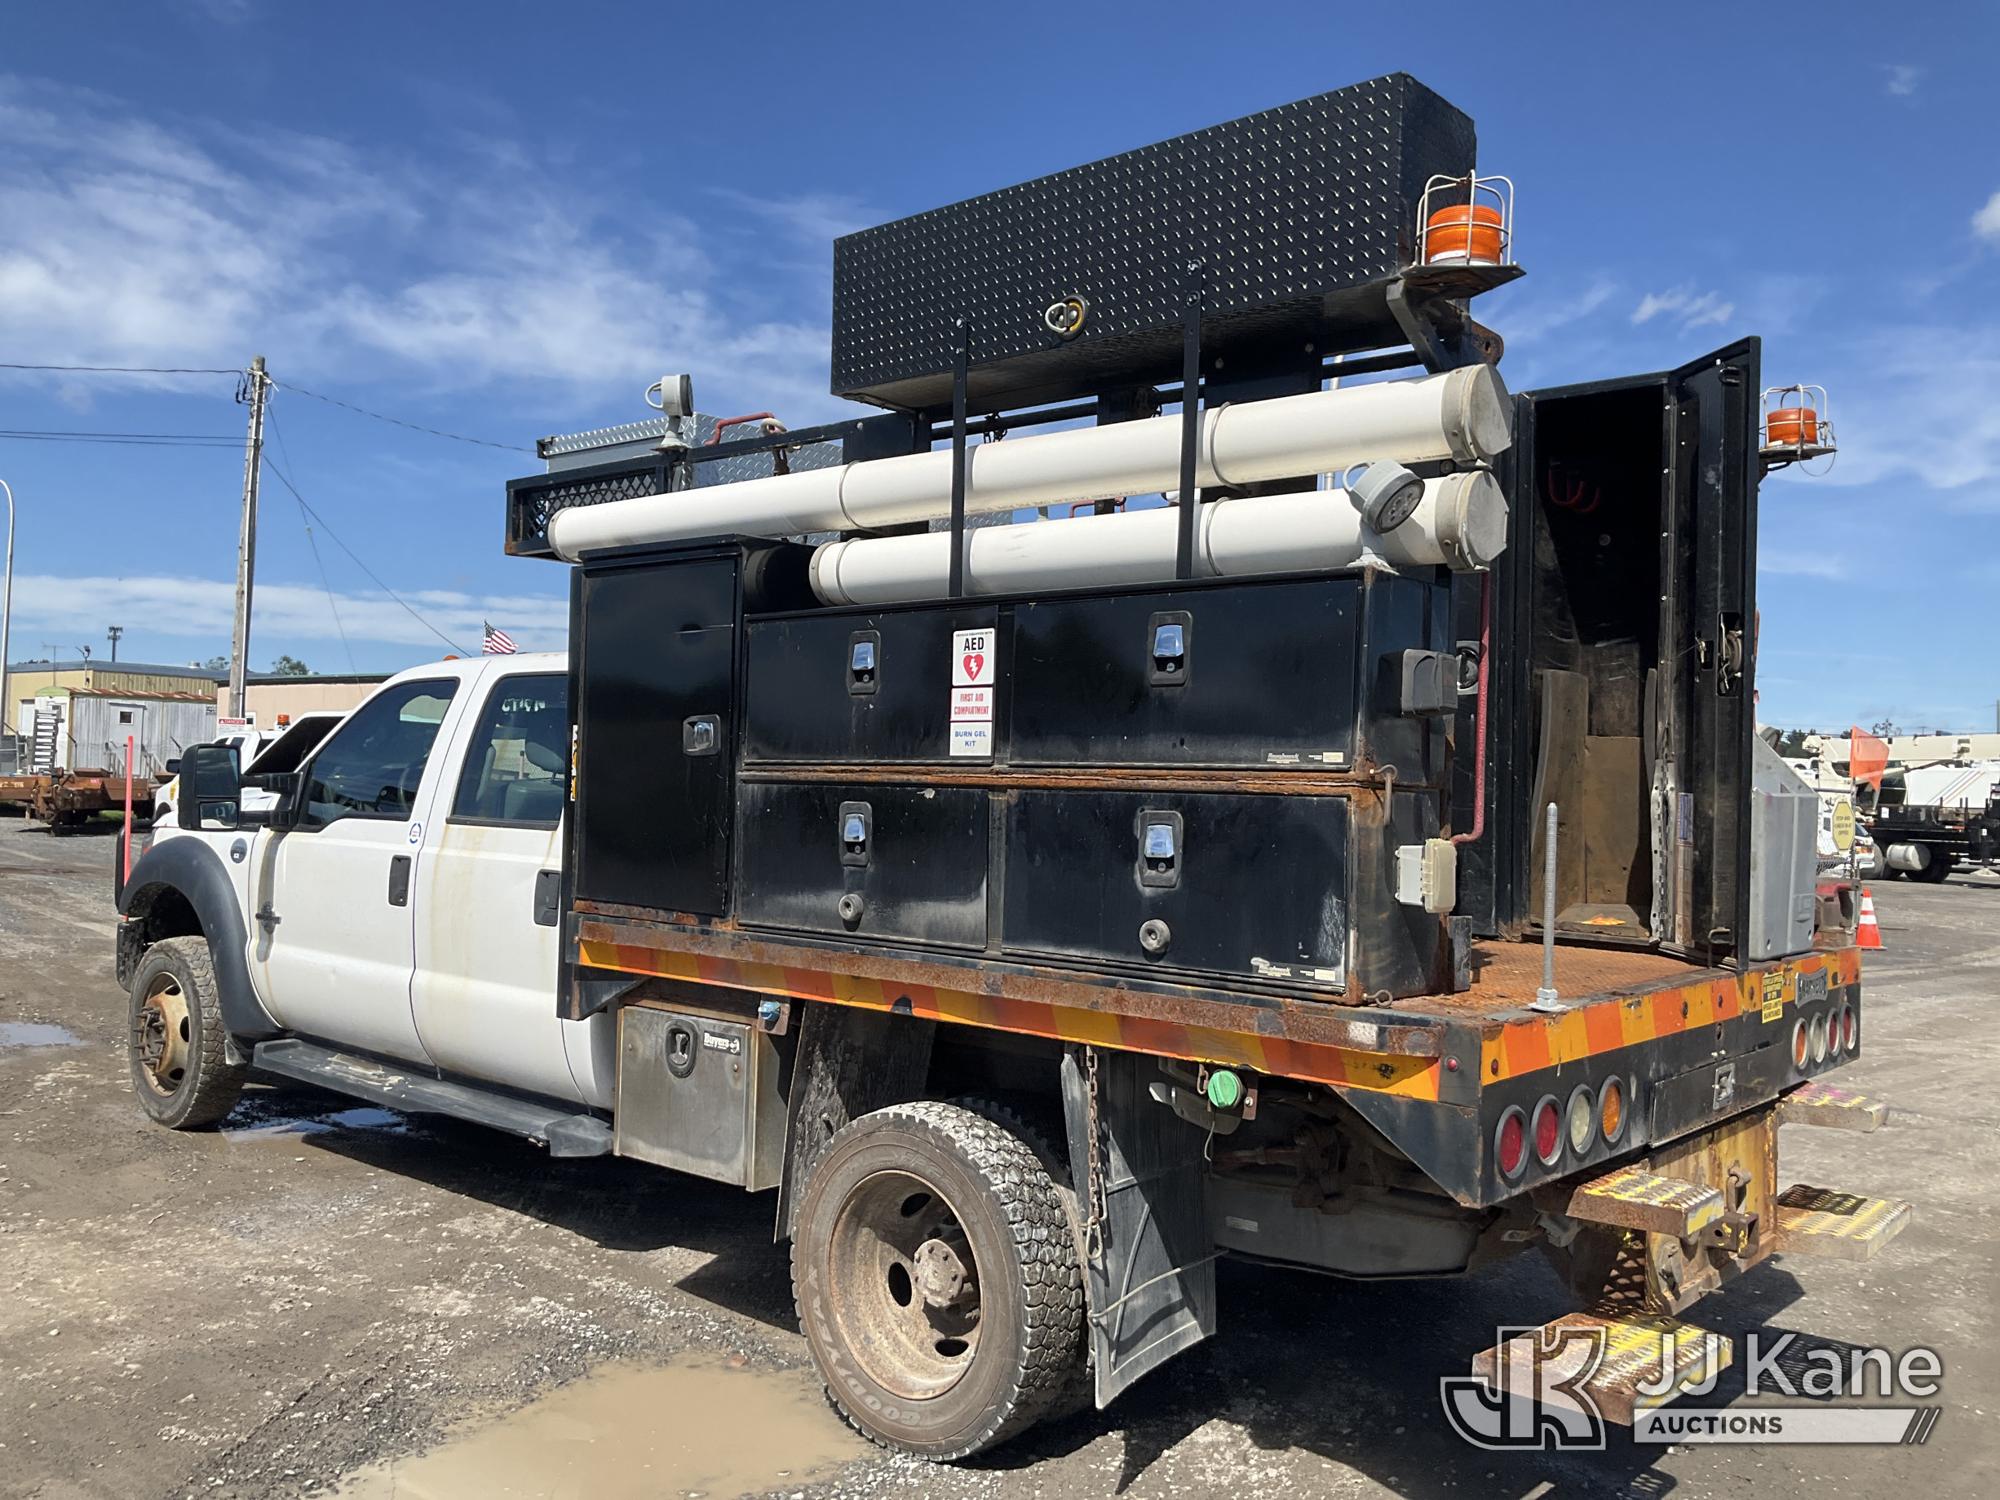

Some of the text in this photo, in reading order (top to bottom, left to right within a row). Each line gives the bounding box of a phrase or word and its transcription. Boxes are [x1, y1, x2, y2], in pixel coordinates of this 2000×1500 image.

[963, 637, 984, 651] AED
[960, 693, 984, 702] FIRST AID
[953, 705, 989, 715] COMPARTMENT
